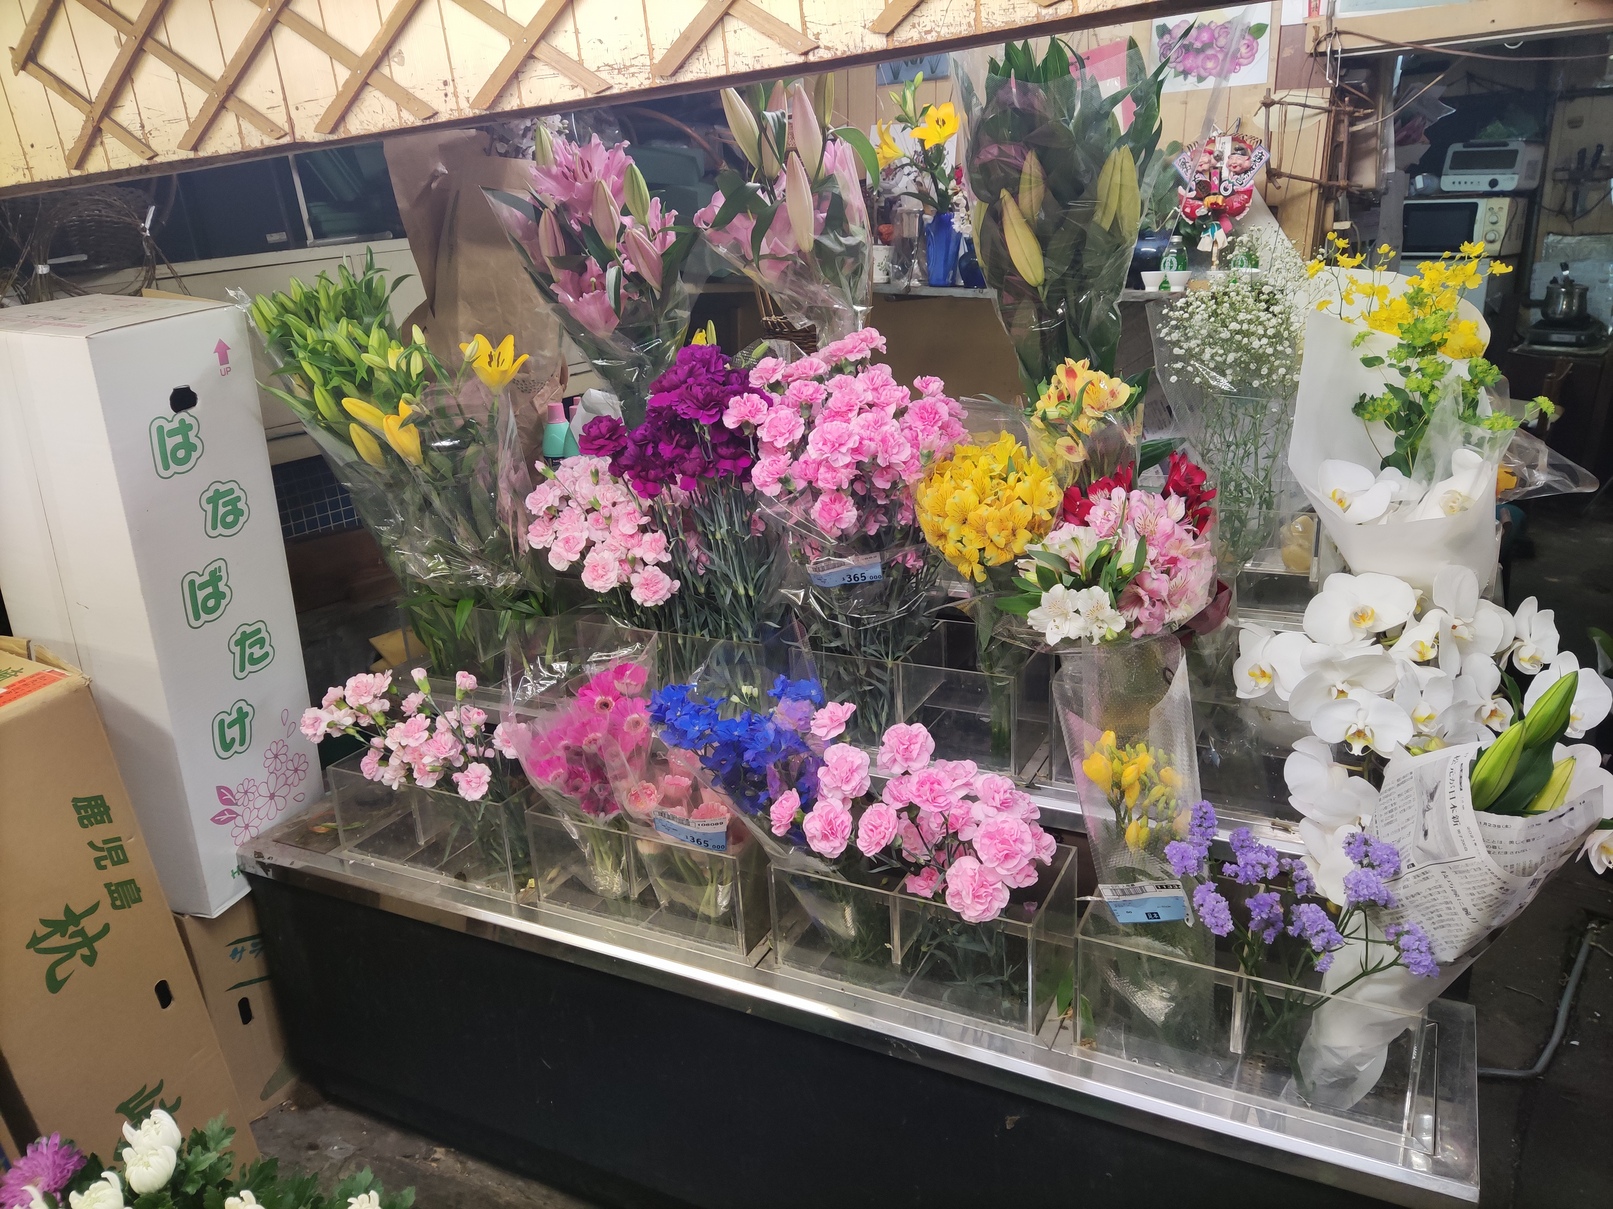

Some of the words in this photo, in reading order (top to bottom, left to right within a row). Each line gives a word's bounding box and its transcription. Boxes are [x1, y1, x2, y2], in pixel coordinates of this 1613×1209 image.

[220, 366, 231, 377] UP
[846, 572, 867, 583] 365
[151, 412, 274, 759] はなばたけ
[689, 835, 709, 848] 365
[71, 794, 144, 911] 鹿児島
